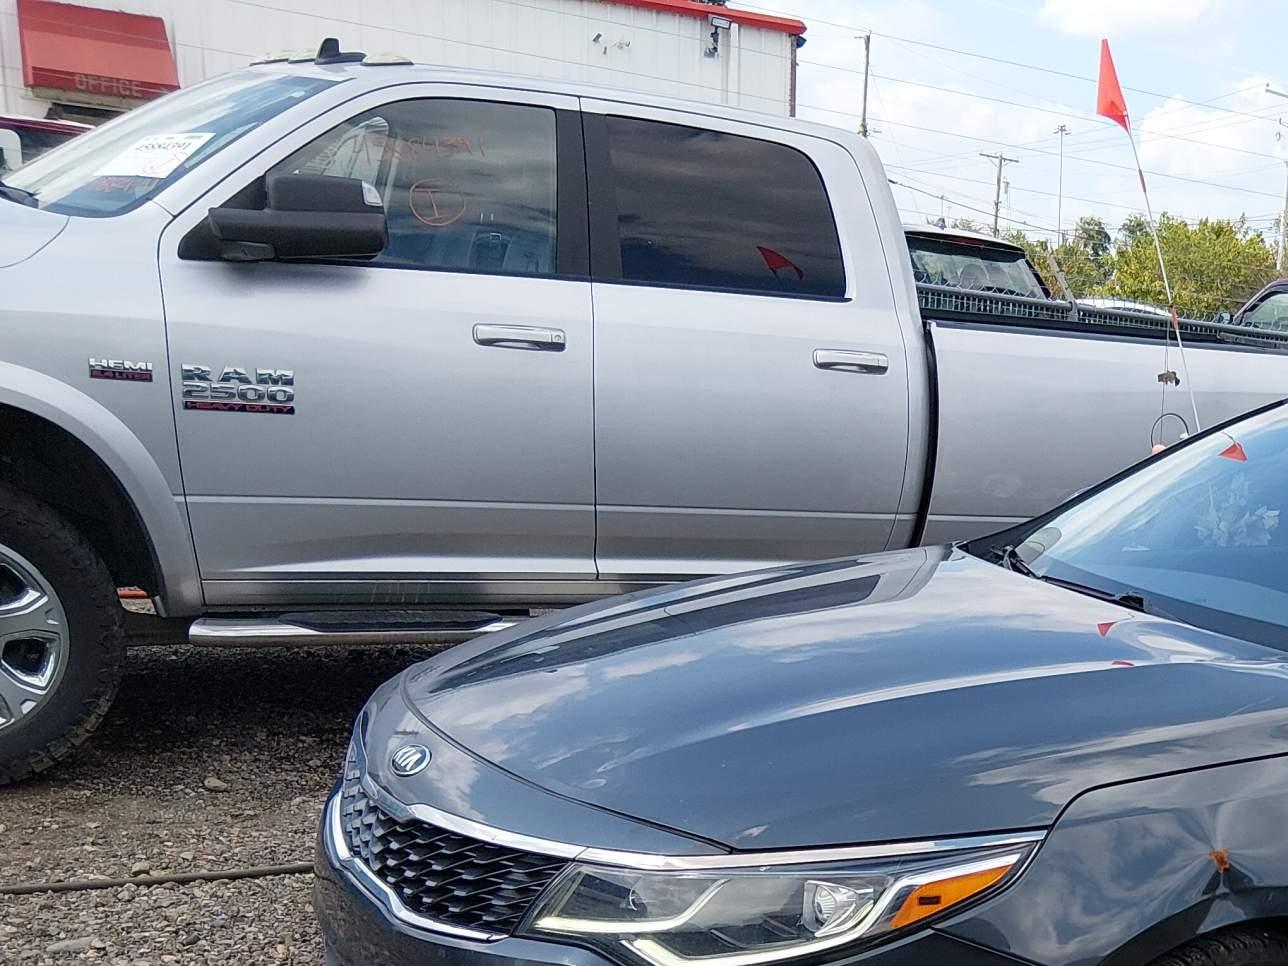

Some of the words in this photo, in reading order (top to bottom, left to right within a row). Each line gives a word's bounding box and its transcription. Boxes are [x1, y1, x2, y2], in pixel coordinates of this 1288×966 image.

[74, 73, 144, 97] OFFICE
[88, 357, 153, 371] HEMI
[181, 363, 295, 386] RAM
[182, 381, 295, 404] 2500
[187, 401, 241, 411] HEAVY
[245, 404, 292, 413] DUTY
[395, 745, 422, 772] KIA
